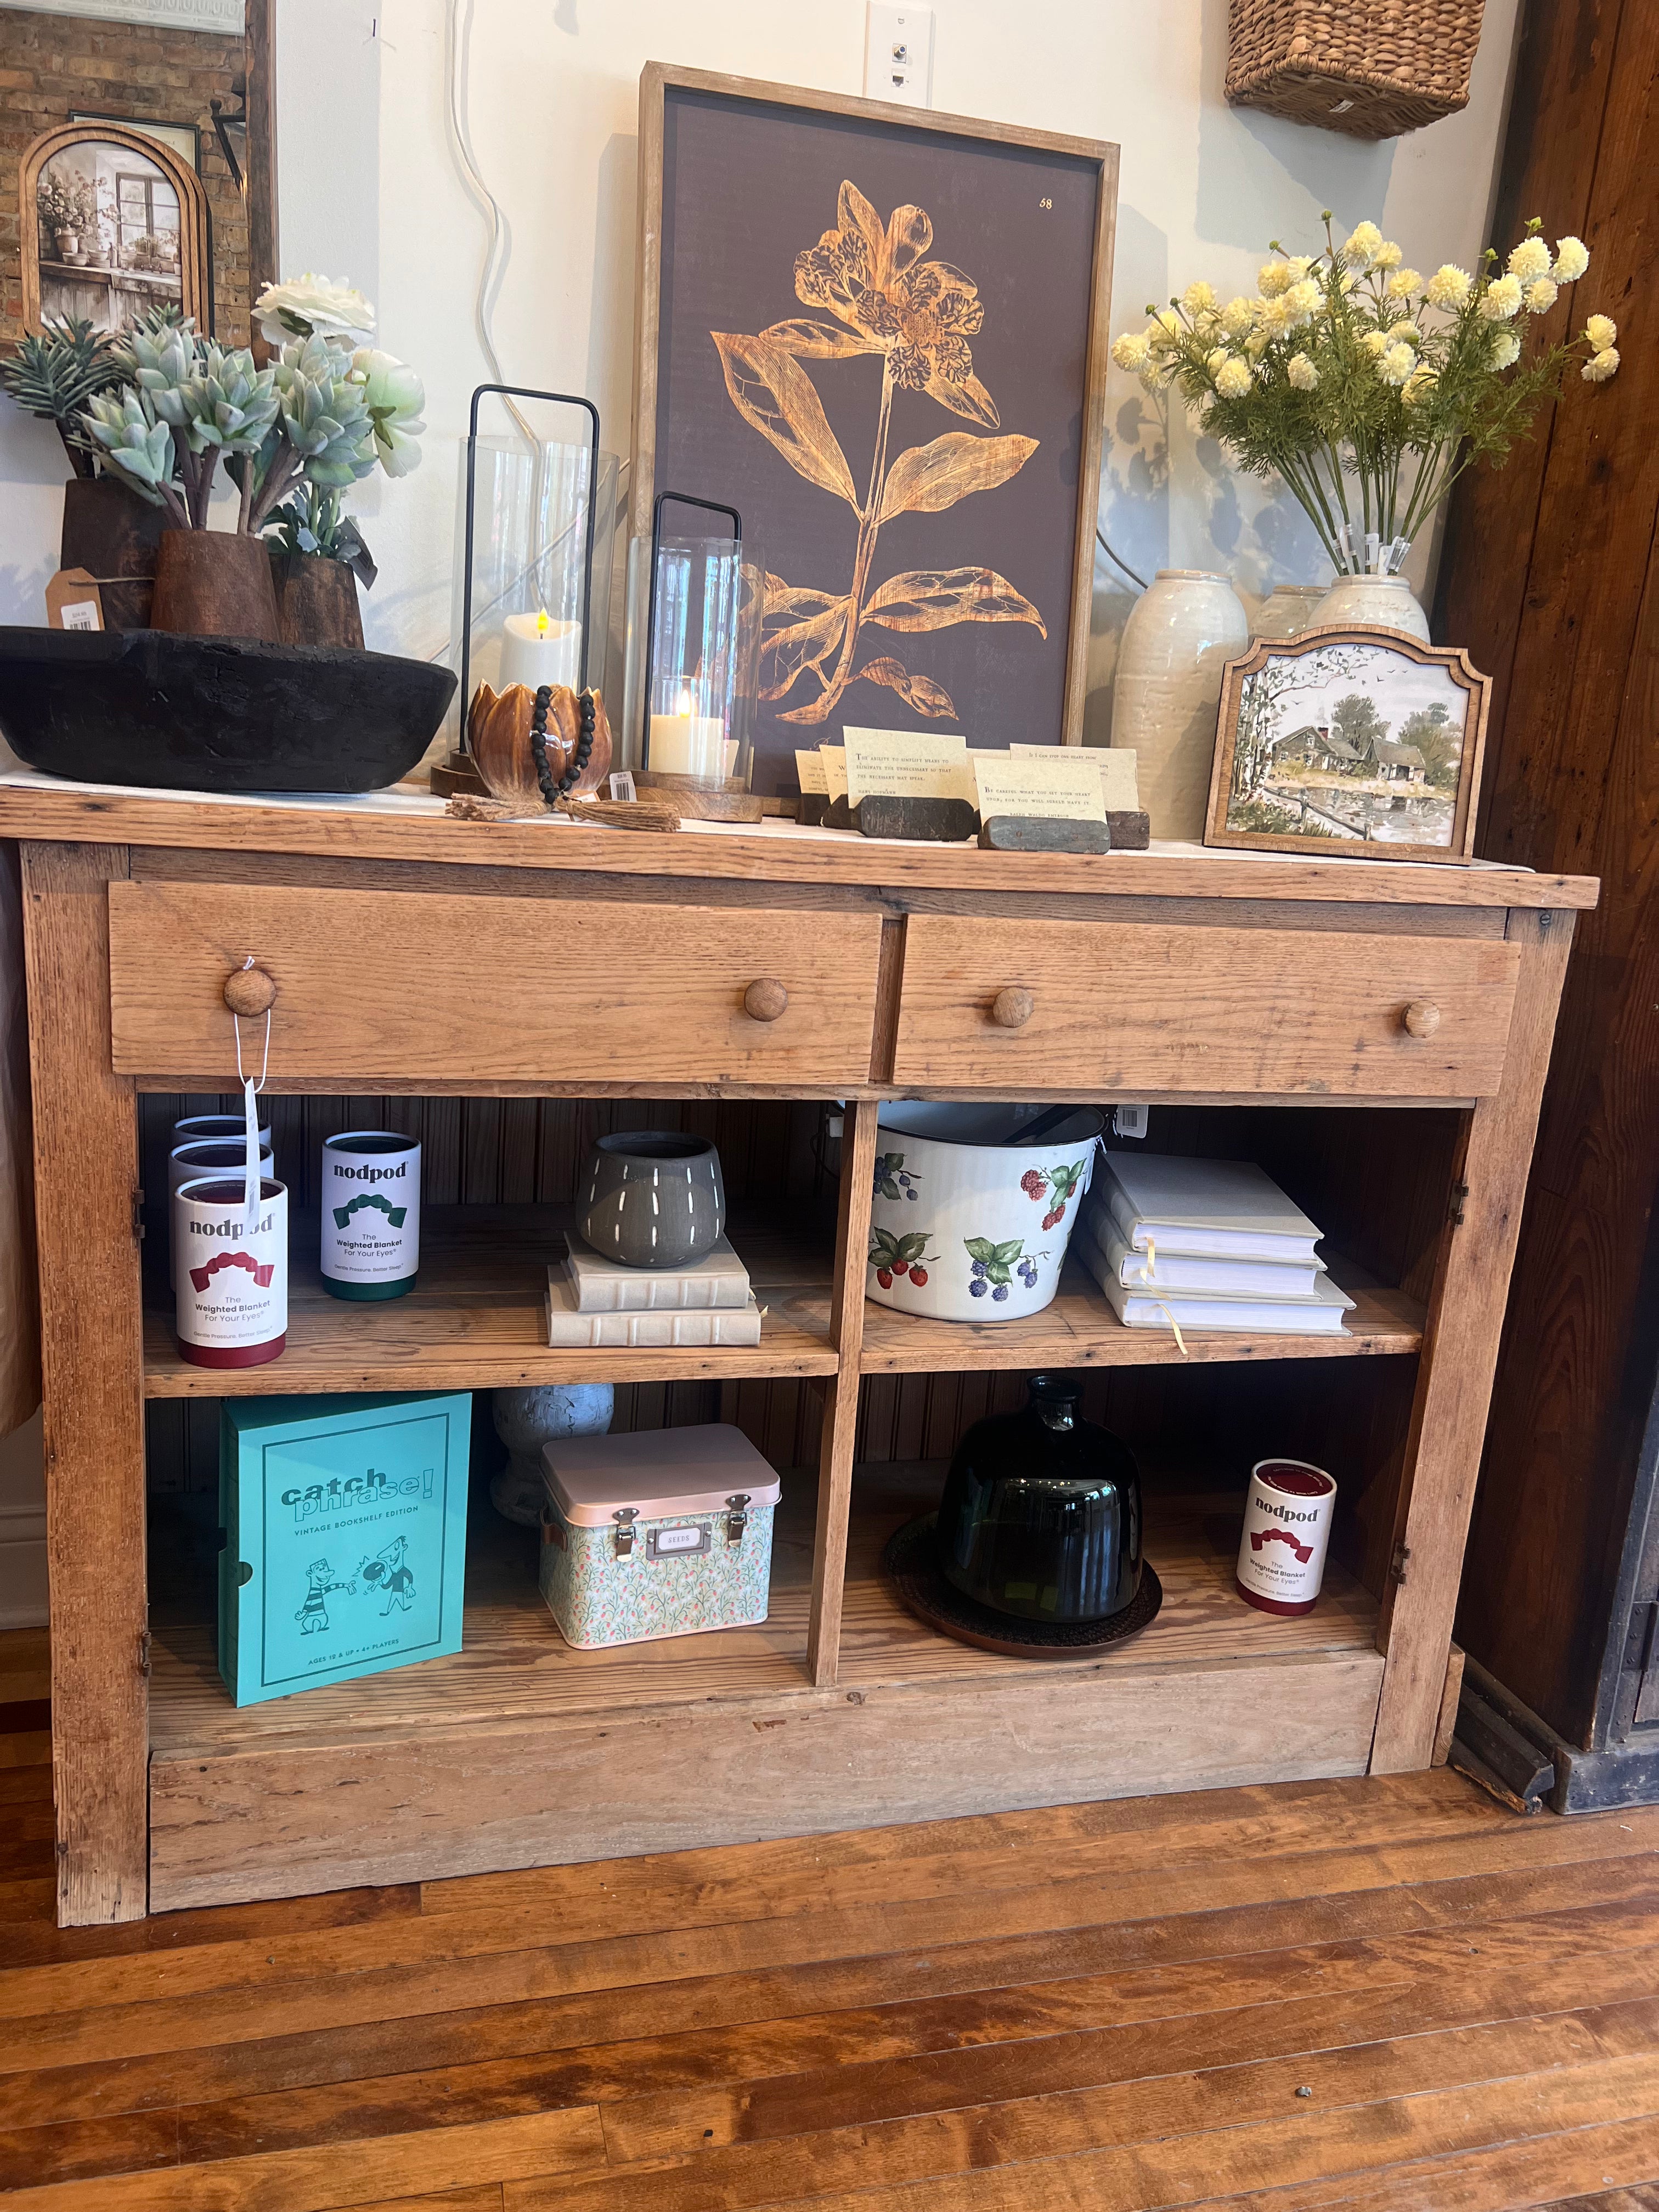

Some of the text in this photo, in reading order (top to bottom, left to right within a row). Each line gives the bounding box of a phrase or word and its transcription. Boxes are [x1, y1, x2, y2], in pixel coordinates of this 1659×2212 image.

[336, 1239, 402, 1249] Weighted Blanket
[195, 1300, 270, 1314] Weighted Blanket
[281, 1468, 386, 1505] catch
[295, 1505, 418, 1536] VINTAGE BOOKSHELF EDITION
[668, 1534, 690, 1543] SEEDS
[1250, 1558, 1278, 1575] Weighted
[1265, 1573, 1280, 1582] Your
[308, 1656, 326, 1666] AGES
[372, 1638, 399, 1650] PLAYERS
